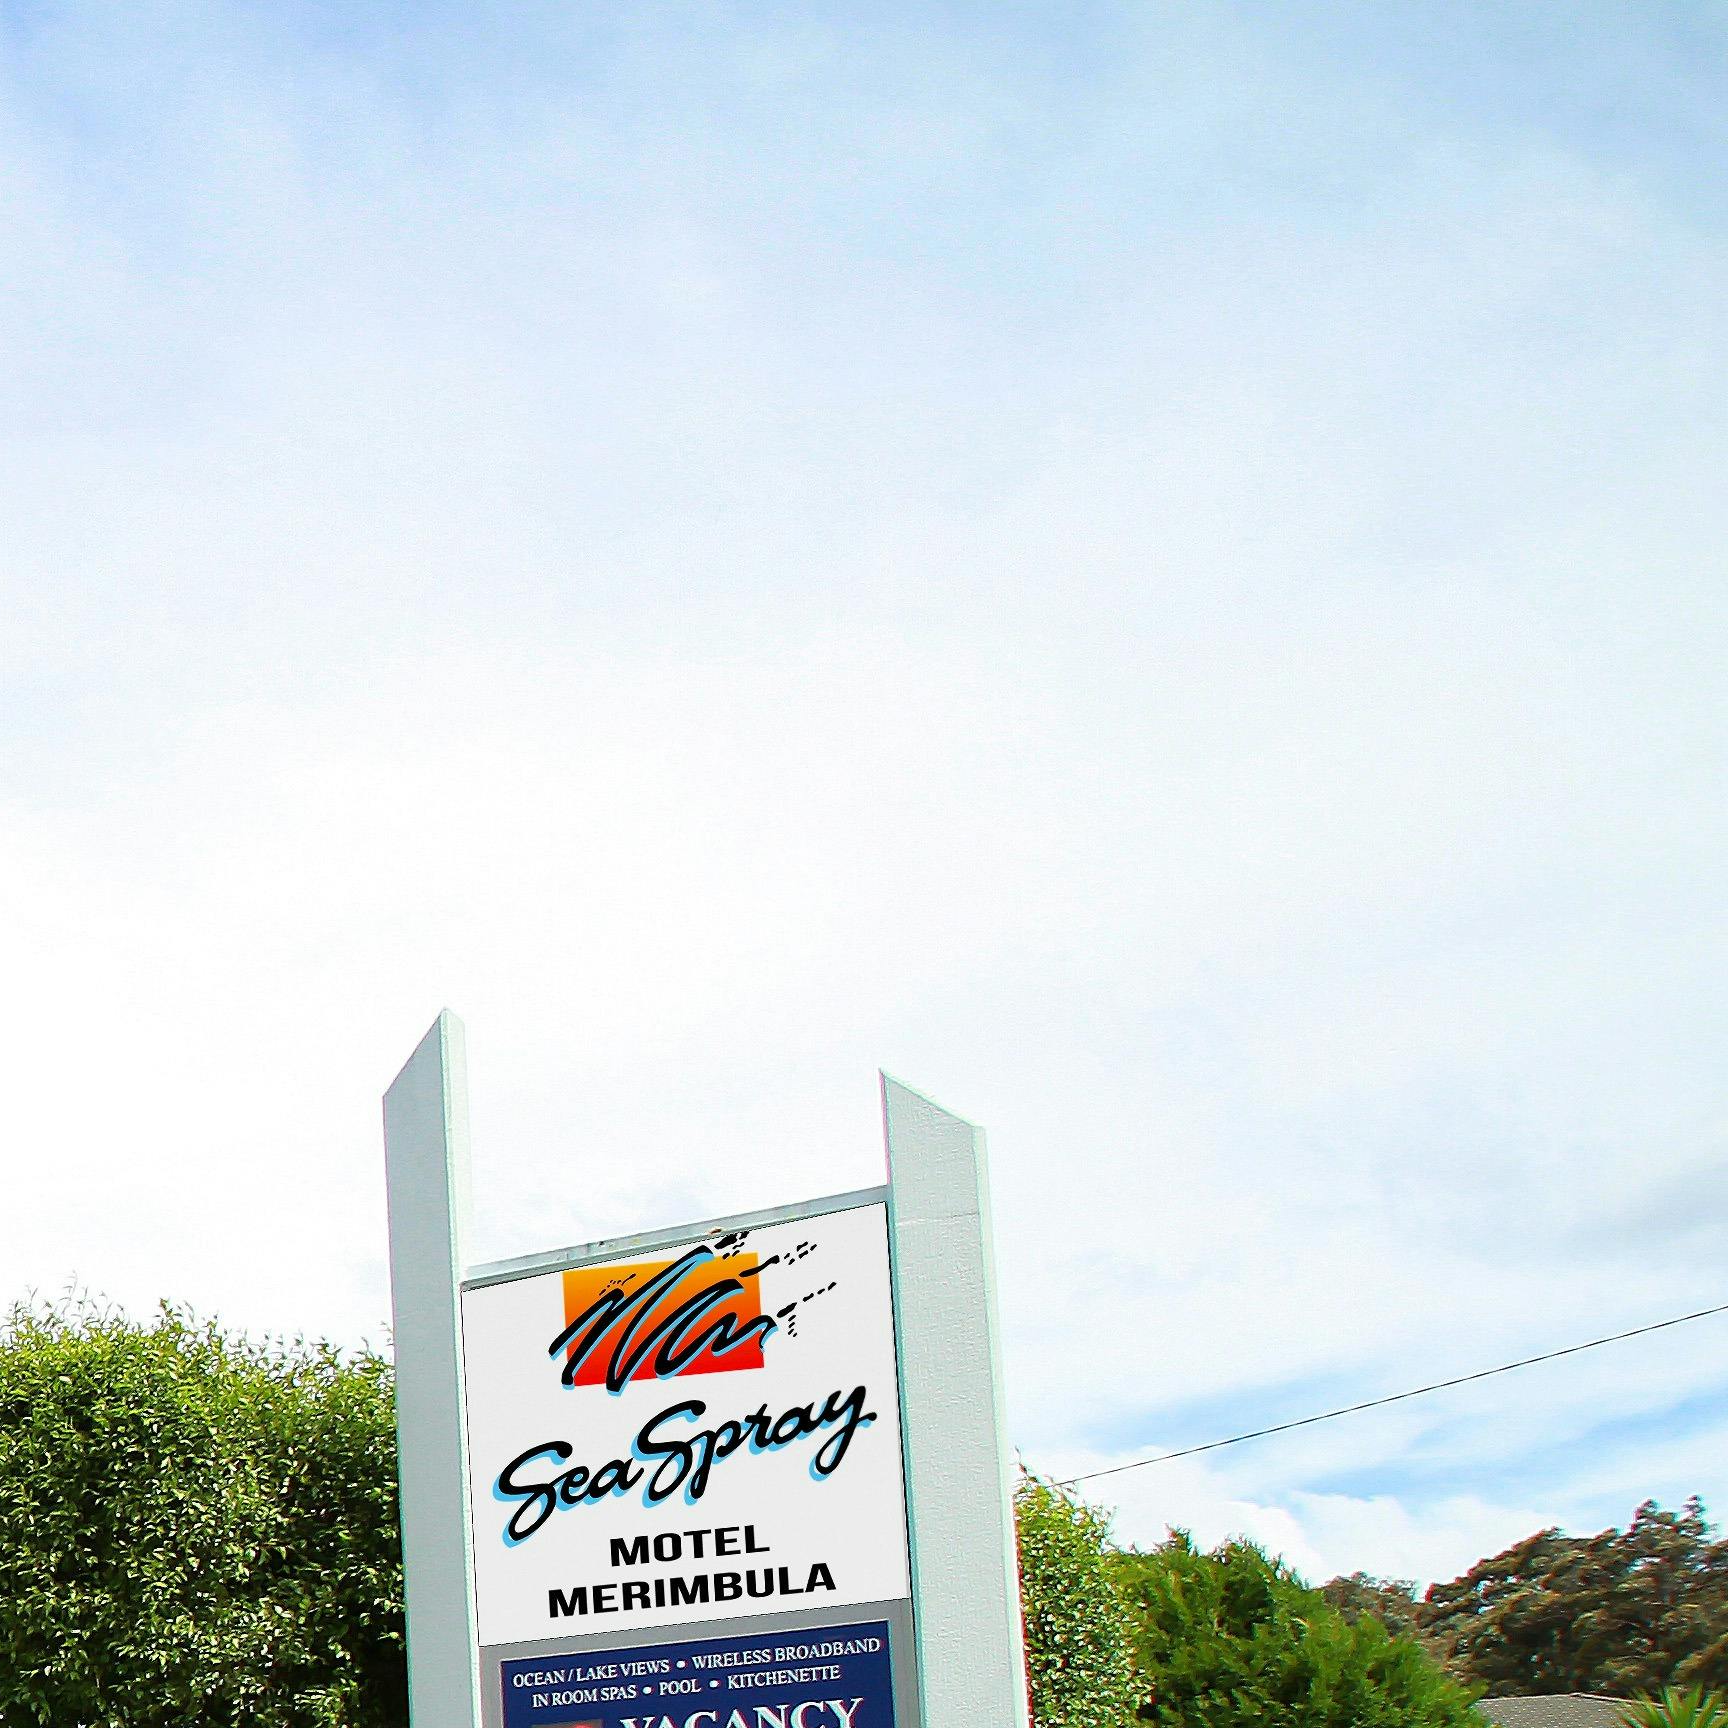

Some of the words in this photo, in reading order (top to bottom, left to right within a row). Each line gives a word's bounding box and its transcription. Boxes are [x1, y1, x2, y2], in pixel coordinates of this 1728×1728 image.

[609, 1524, 771, 1567] MOTEL
[547, 1562, 837, 1619] MERIMBULA
[512, 1669, 565, 1688] OCEAN
[575, 1664, 618, 1682] LAKE
[620, 1659, 671, 1677] VIEWS
[692, 1648, 771, 1670] WIRELESS
[774, 1637, 881, 1662] BROADBAND
[532, 1692, 549, 1708] IN
[551, 1687, 598, 1707] ROOM
[600, 1684, 637, 1702] SPAS
[658, 1678, 702, 1696] POOL
[727, 1664, 842, 1690] KITCHENETTE
